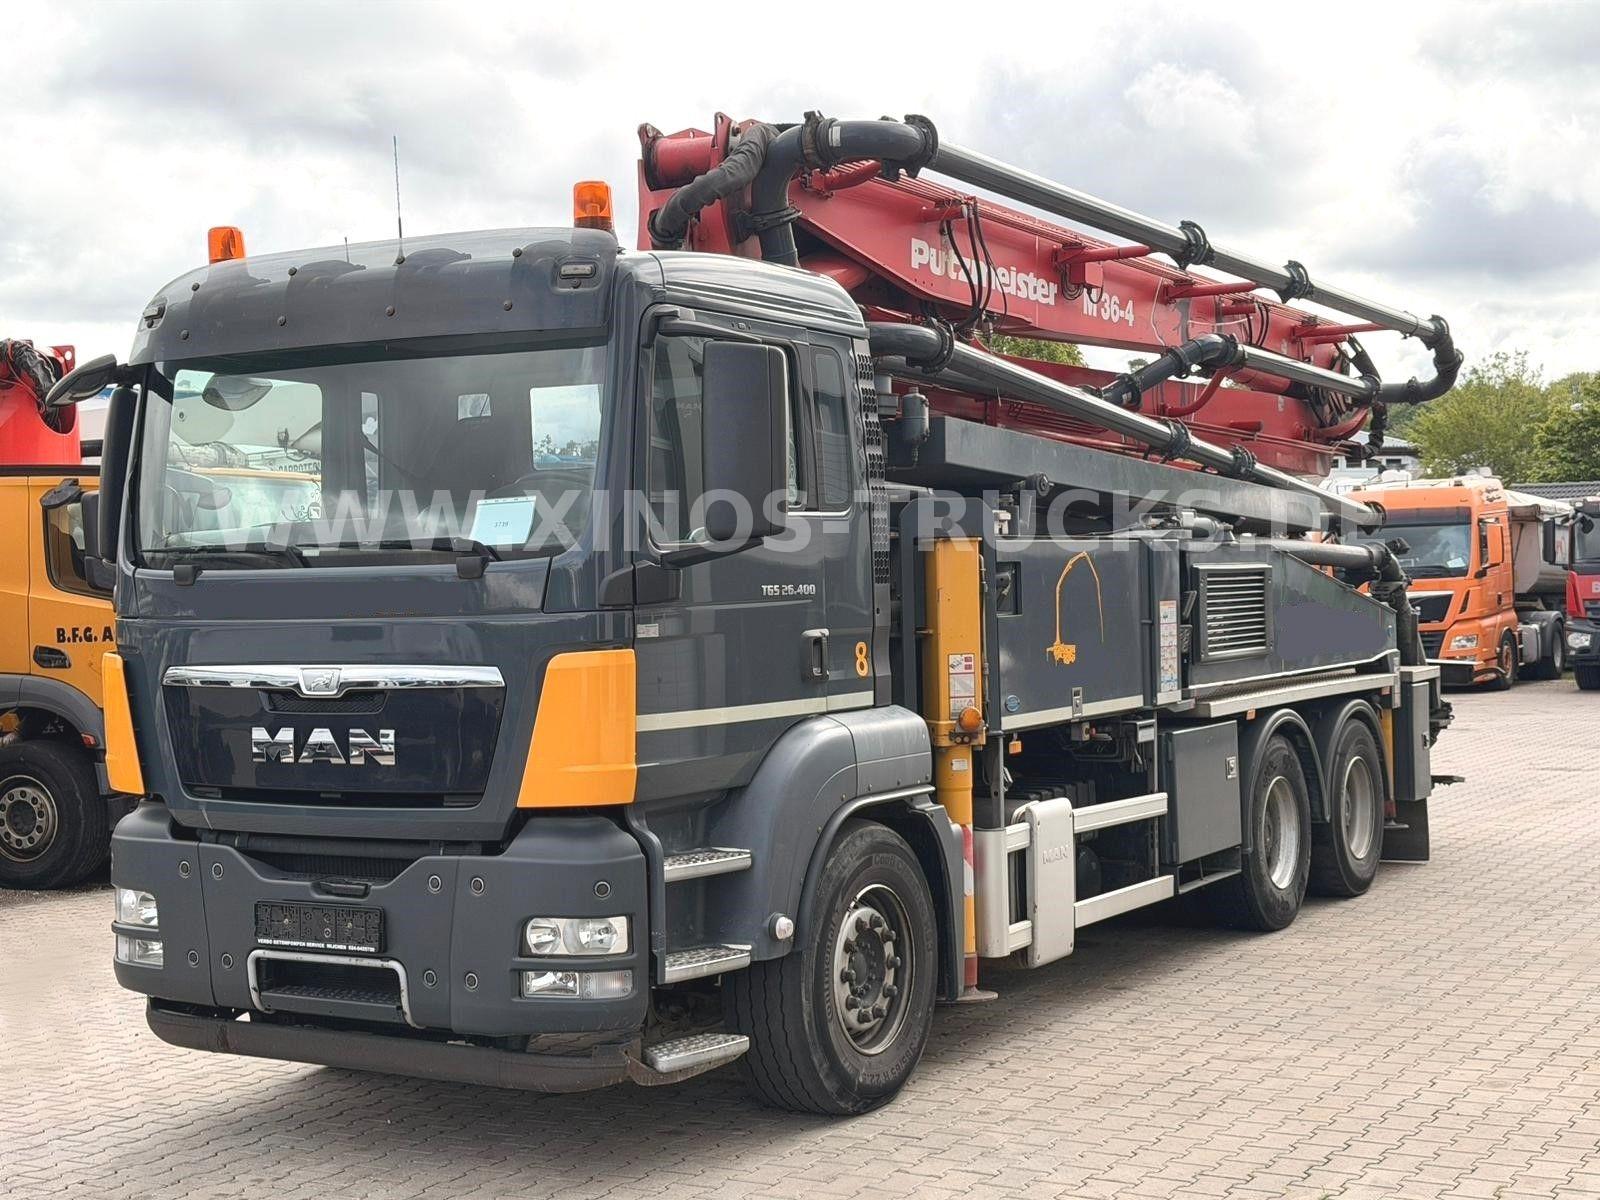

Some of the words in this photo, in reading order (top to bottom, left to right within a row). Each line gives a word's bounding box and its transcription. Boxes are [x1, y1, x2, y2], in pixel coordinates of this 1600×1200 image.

[1083, 287, 1098, 317] M
[1101, 293, 1134, 327] 36-4
[762, 585, 779, 596] TGS
[782, 584, 816, 595] 26.400
[56, 626, 98, 644] B.F.G.
[855, 641, 869, 677] 8
[252, 727, 395, 765] MAN
